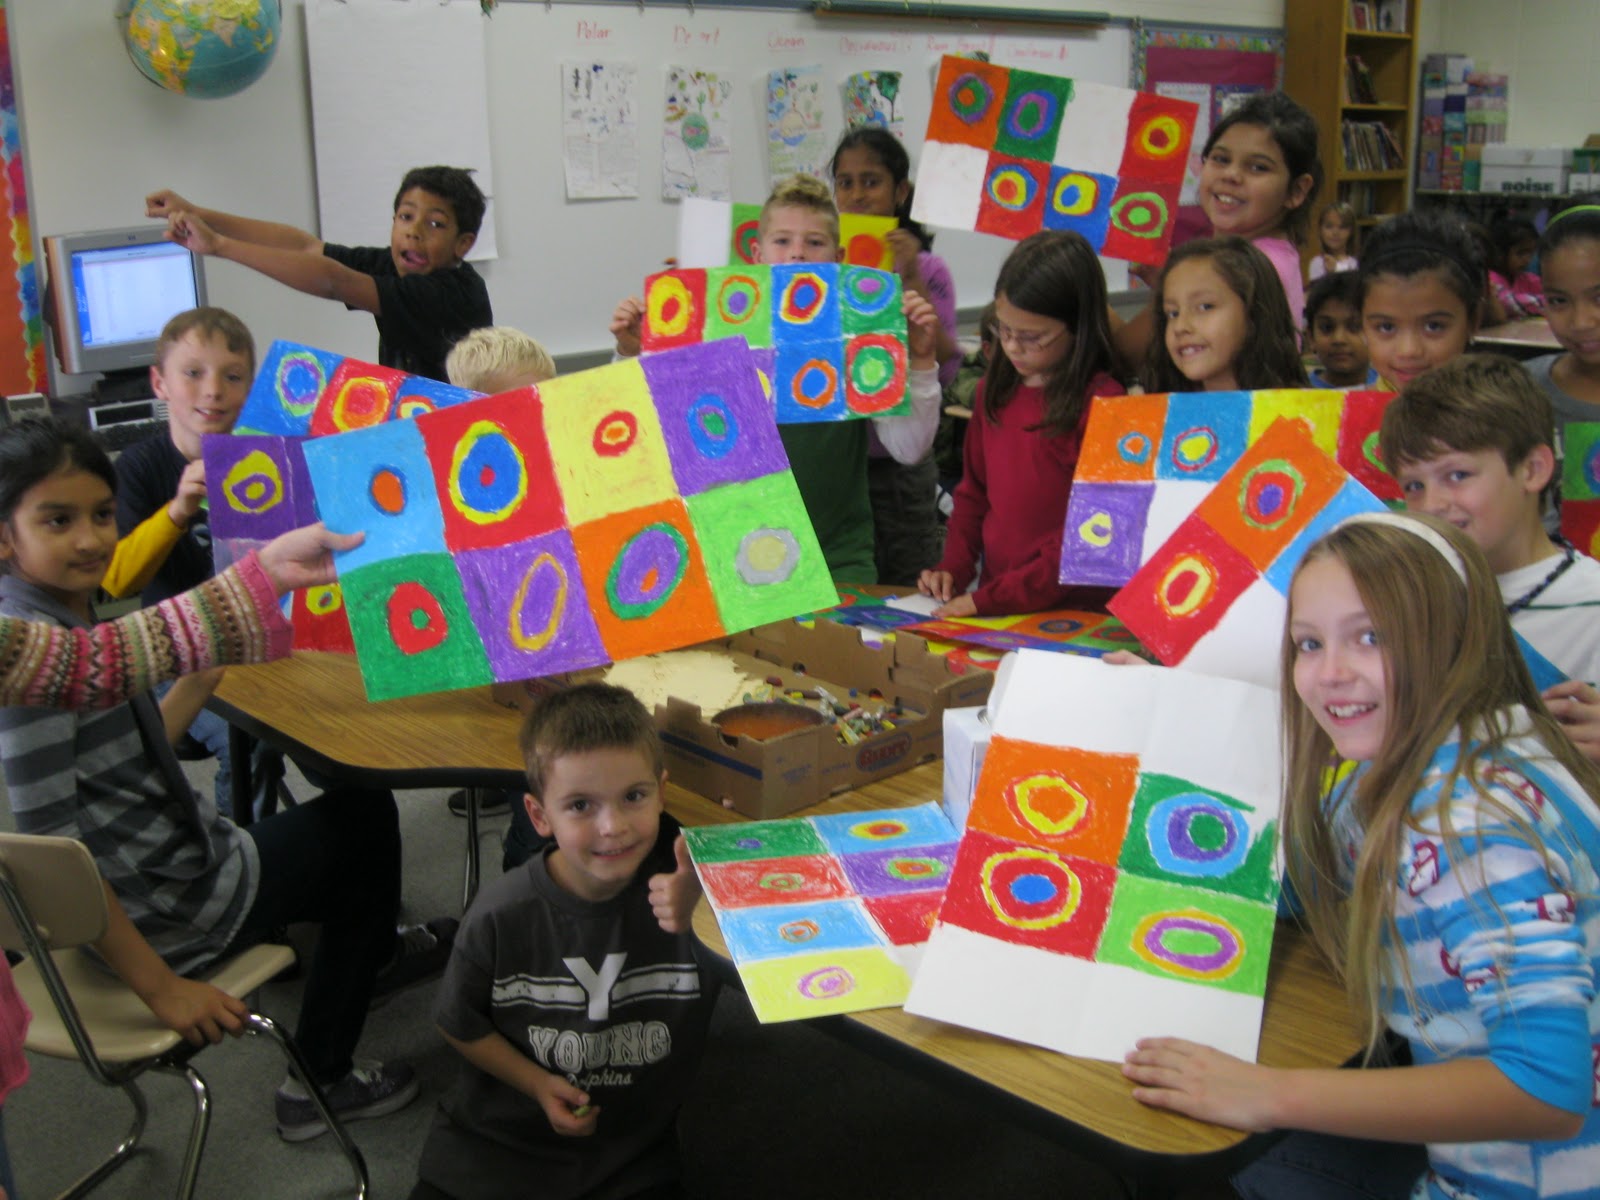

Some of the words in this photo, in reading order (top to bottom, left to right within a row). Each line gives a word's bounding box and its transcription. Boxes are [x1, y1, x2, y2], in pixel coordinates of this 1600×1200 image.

[576, 20, 611, 40] Polar
[562, 952, 628, 1020] Y
[528, 1022, 671, 1073] YOUNG
